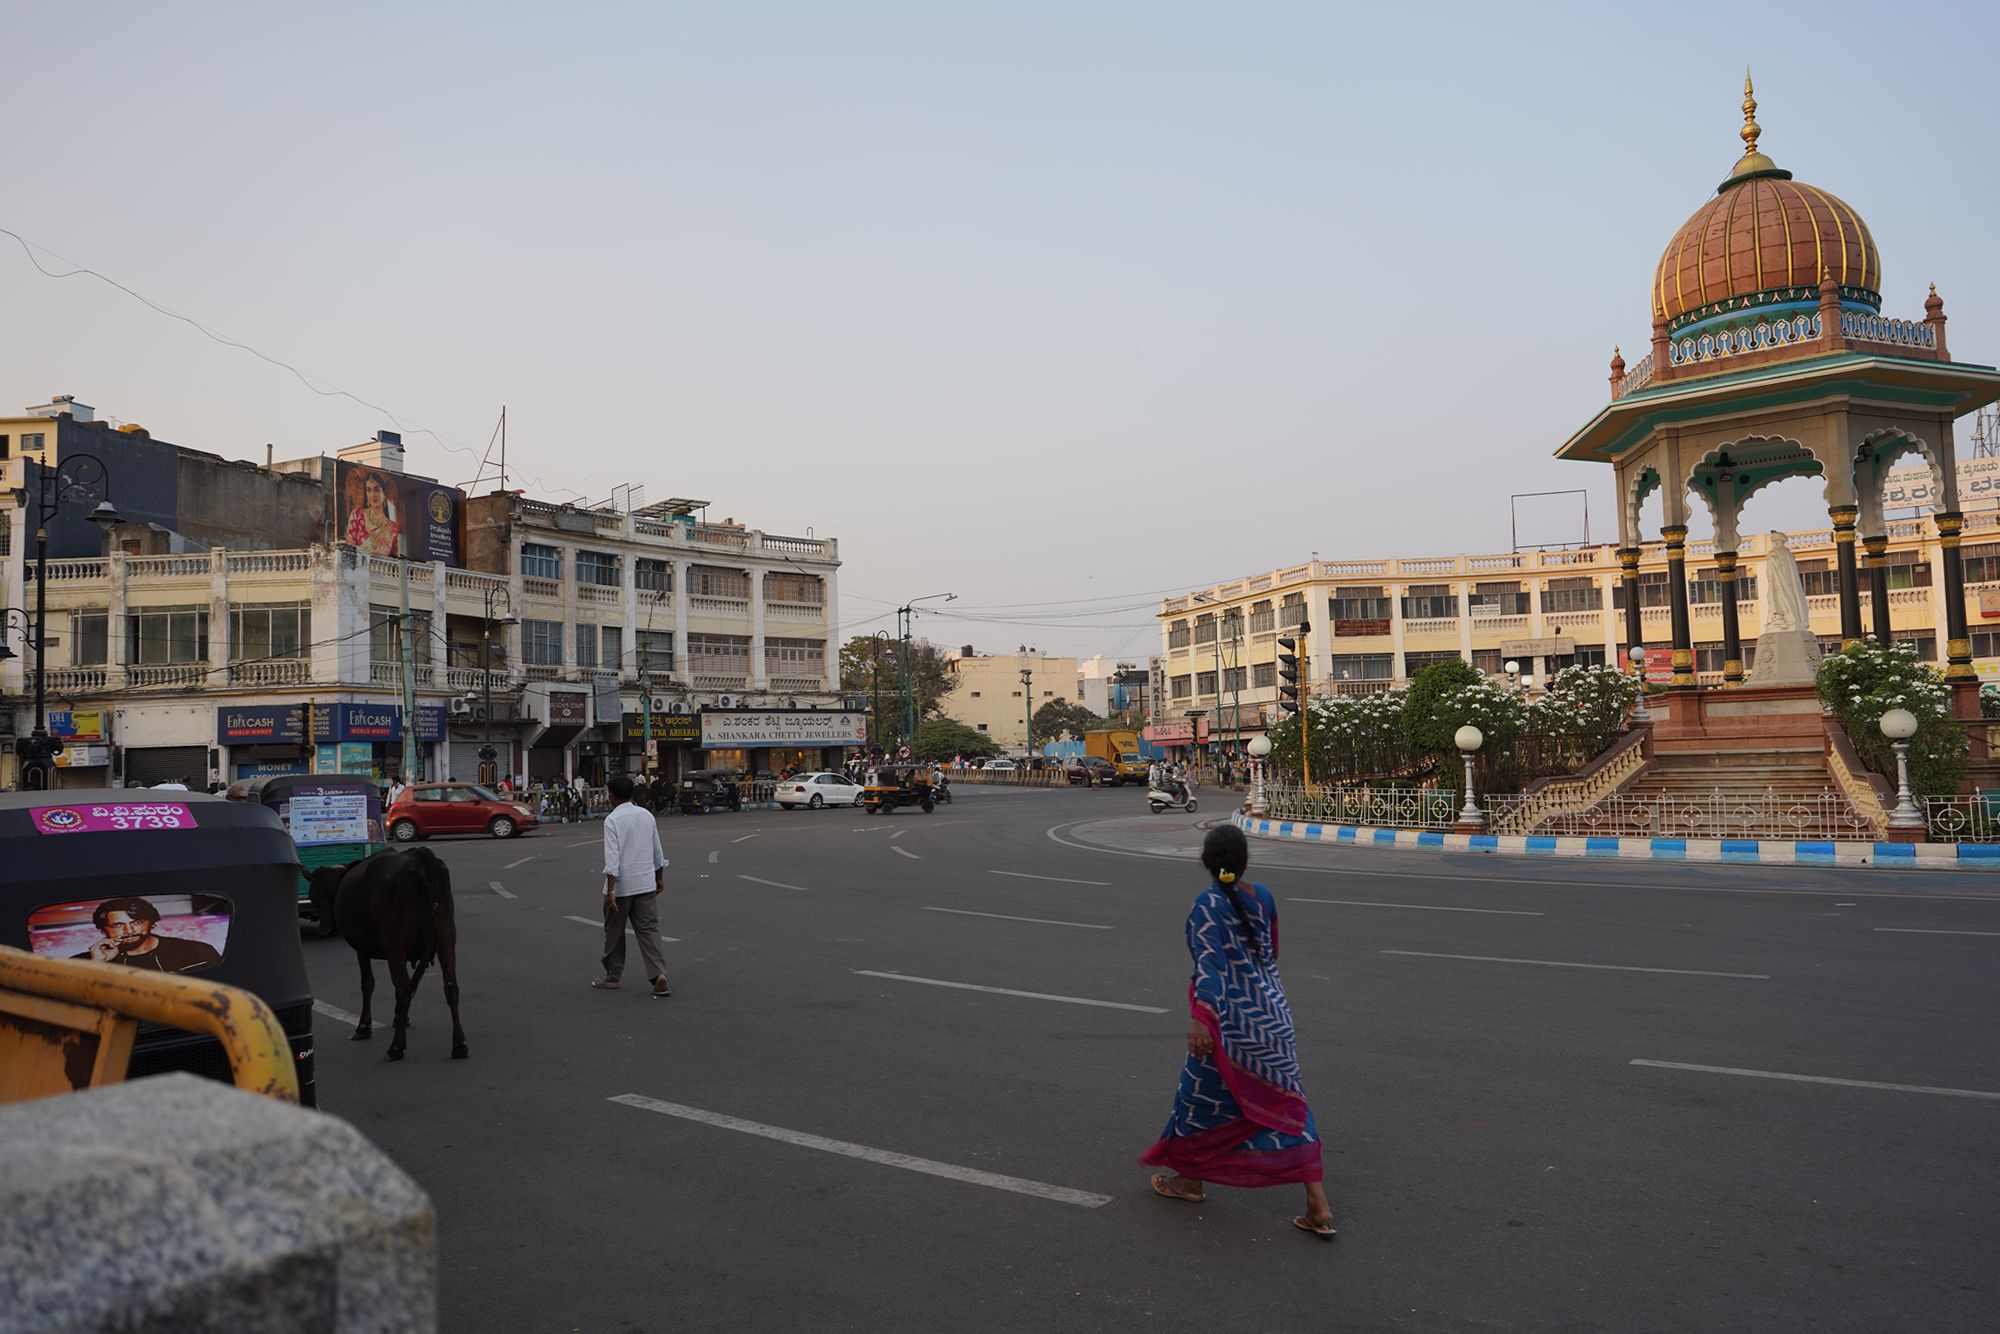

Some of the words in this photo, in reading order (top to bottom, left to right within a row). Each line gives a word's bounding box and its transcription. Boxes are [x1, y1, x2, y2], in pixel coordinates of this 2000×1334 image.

[669, 728, 700, 737] ABHARAN
[718, 731, 766, 740] SHANKARA
[769, 731, 802, 739] CHETTY
[805, 731, 852, 739] JEWELLERS
[257, 763, 293, 771] MONEY
[317, 787, 324, 796] 3
[111, 815, 180, 829] 3739
